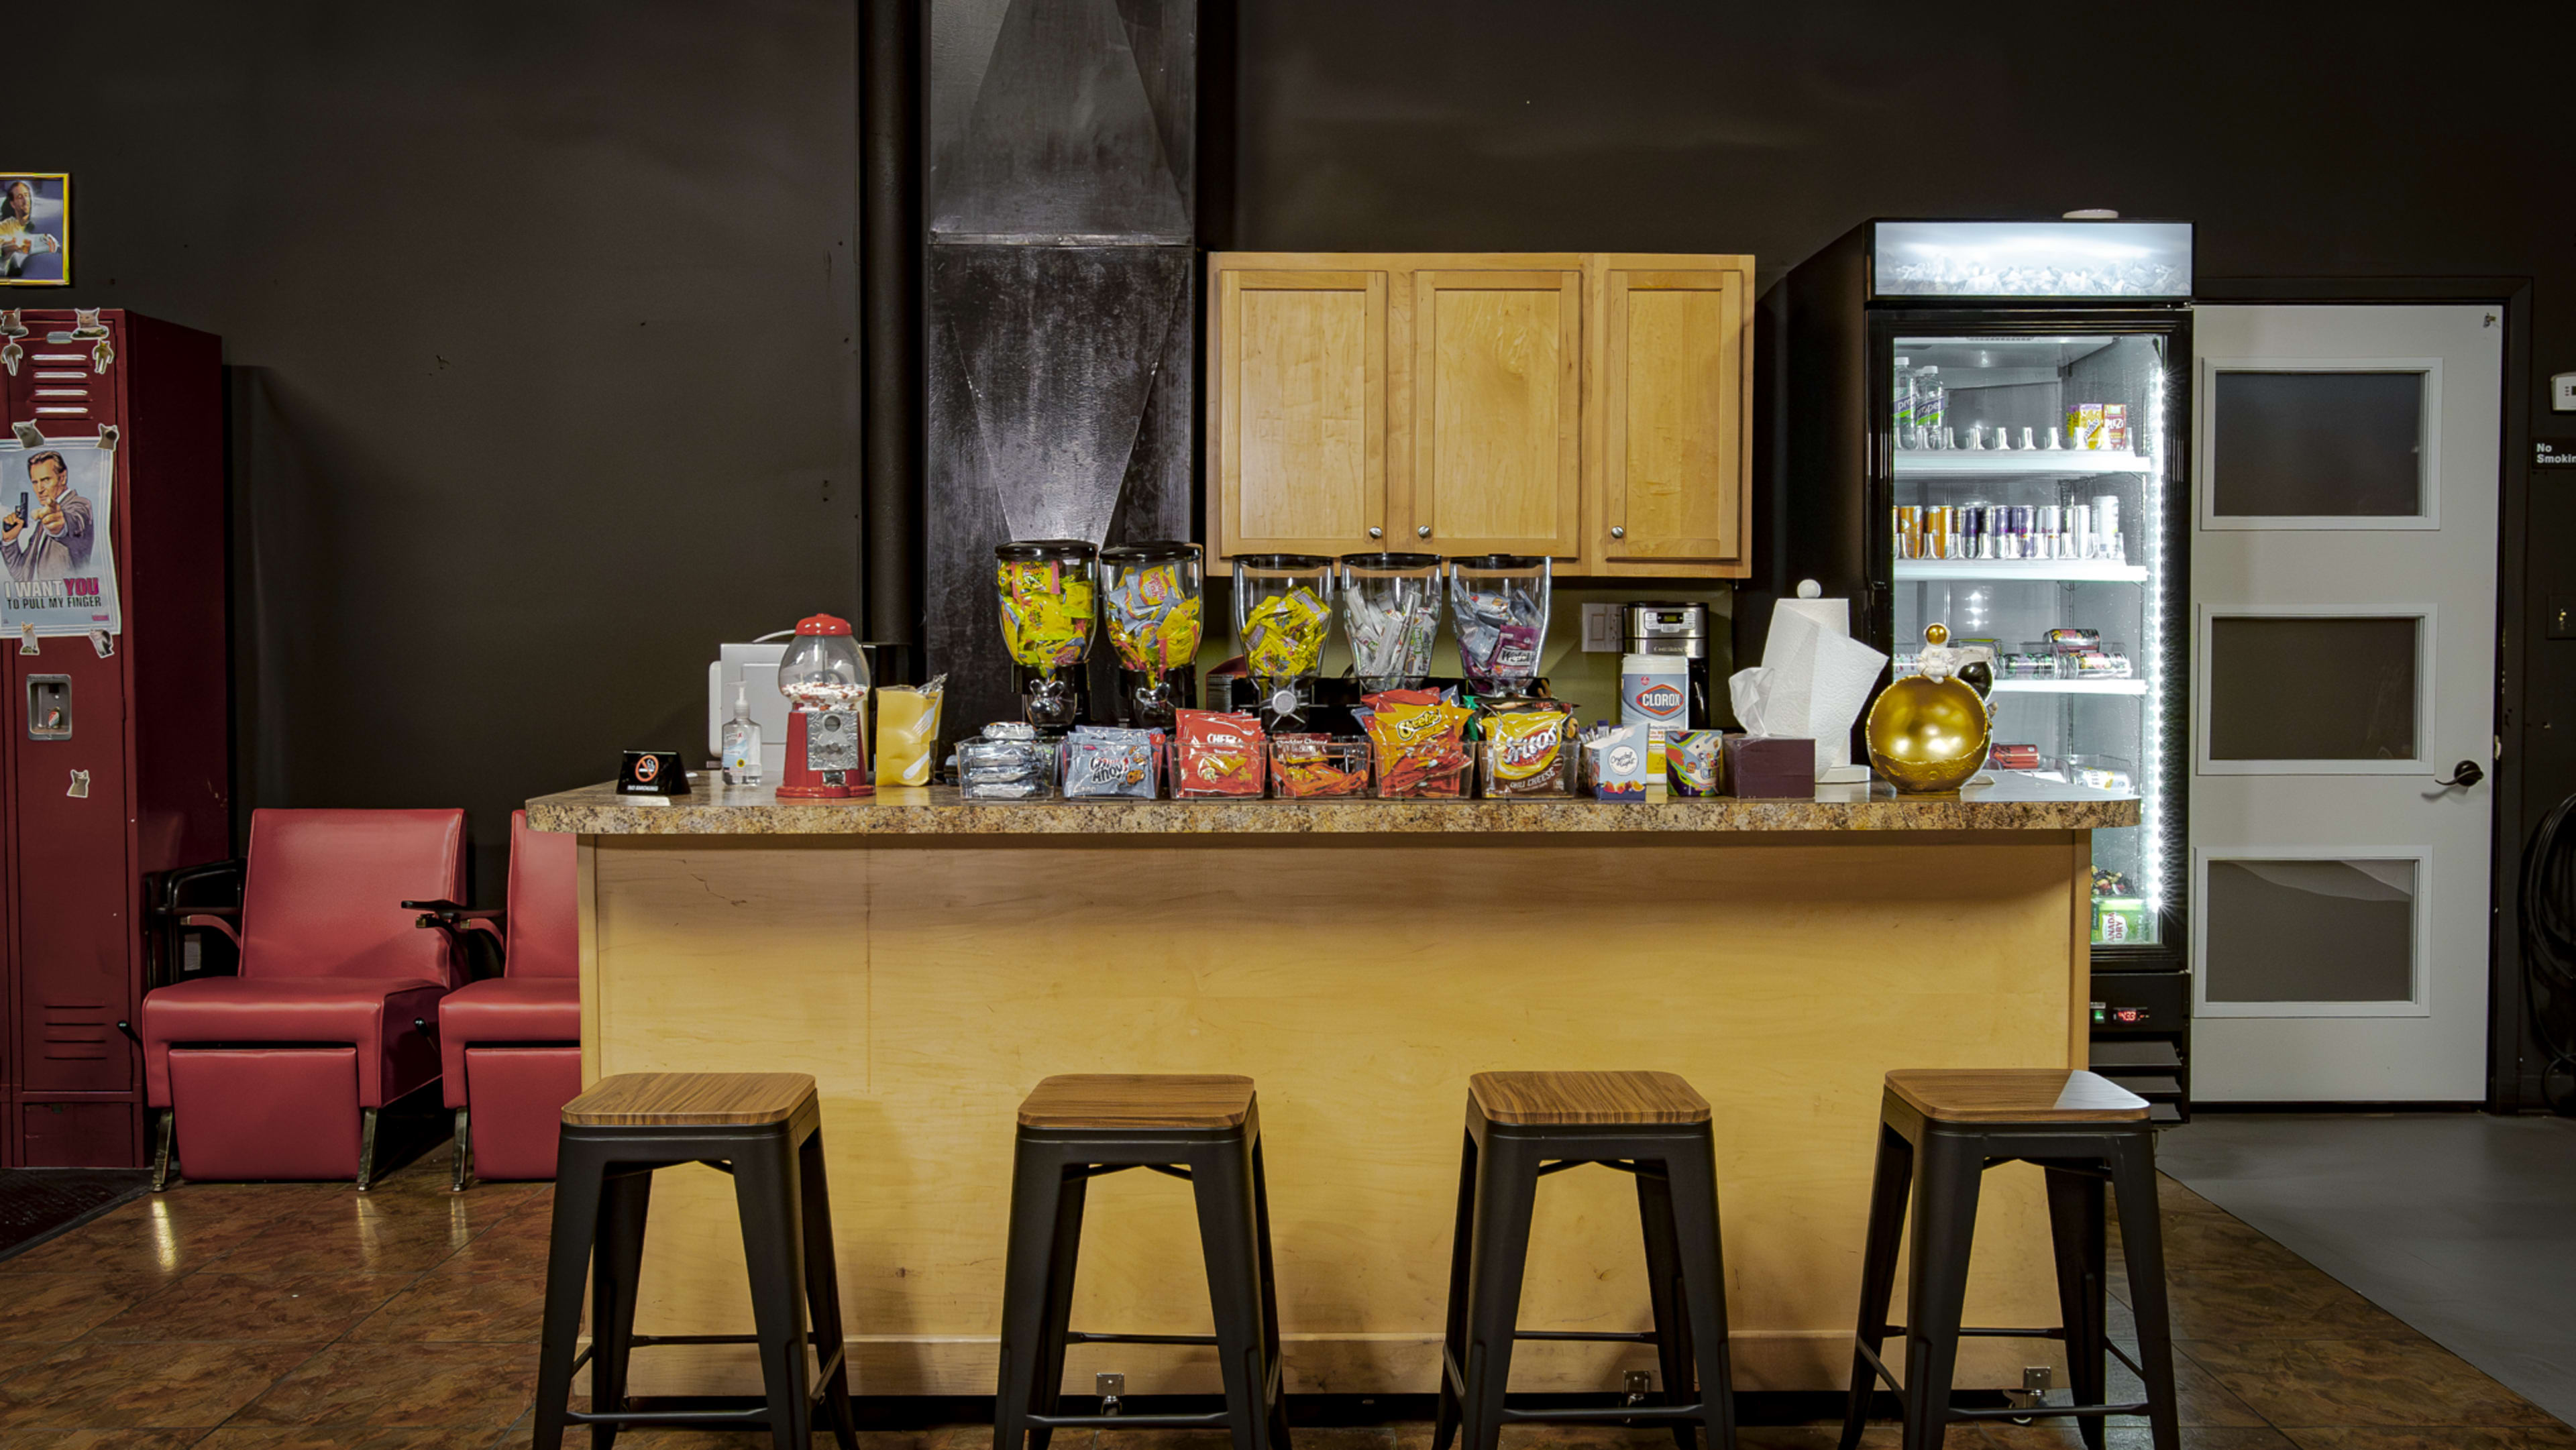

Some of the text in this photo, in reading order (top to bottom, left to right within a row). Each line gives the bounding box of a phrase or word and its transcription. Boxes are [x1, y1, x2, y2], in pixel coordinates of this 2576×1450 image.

[2536, 443, 2553, 453] No
[5, 577, 99, 598] I WANT YOU
[7, 596, 102, 610] TO PULL MY FINGER
[1642, 693, 1680, 706] CLOROX
[1503, 722, 1558, 765] Fritos
[1527, 767, 1556, 787] CHEESE
[2115, 921, 2123, 939] DRY
